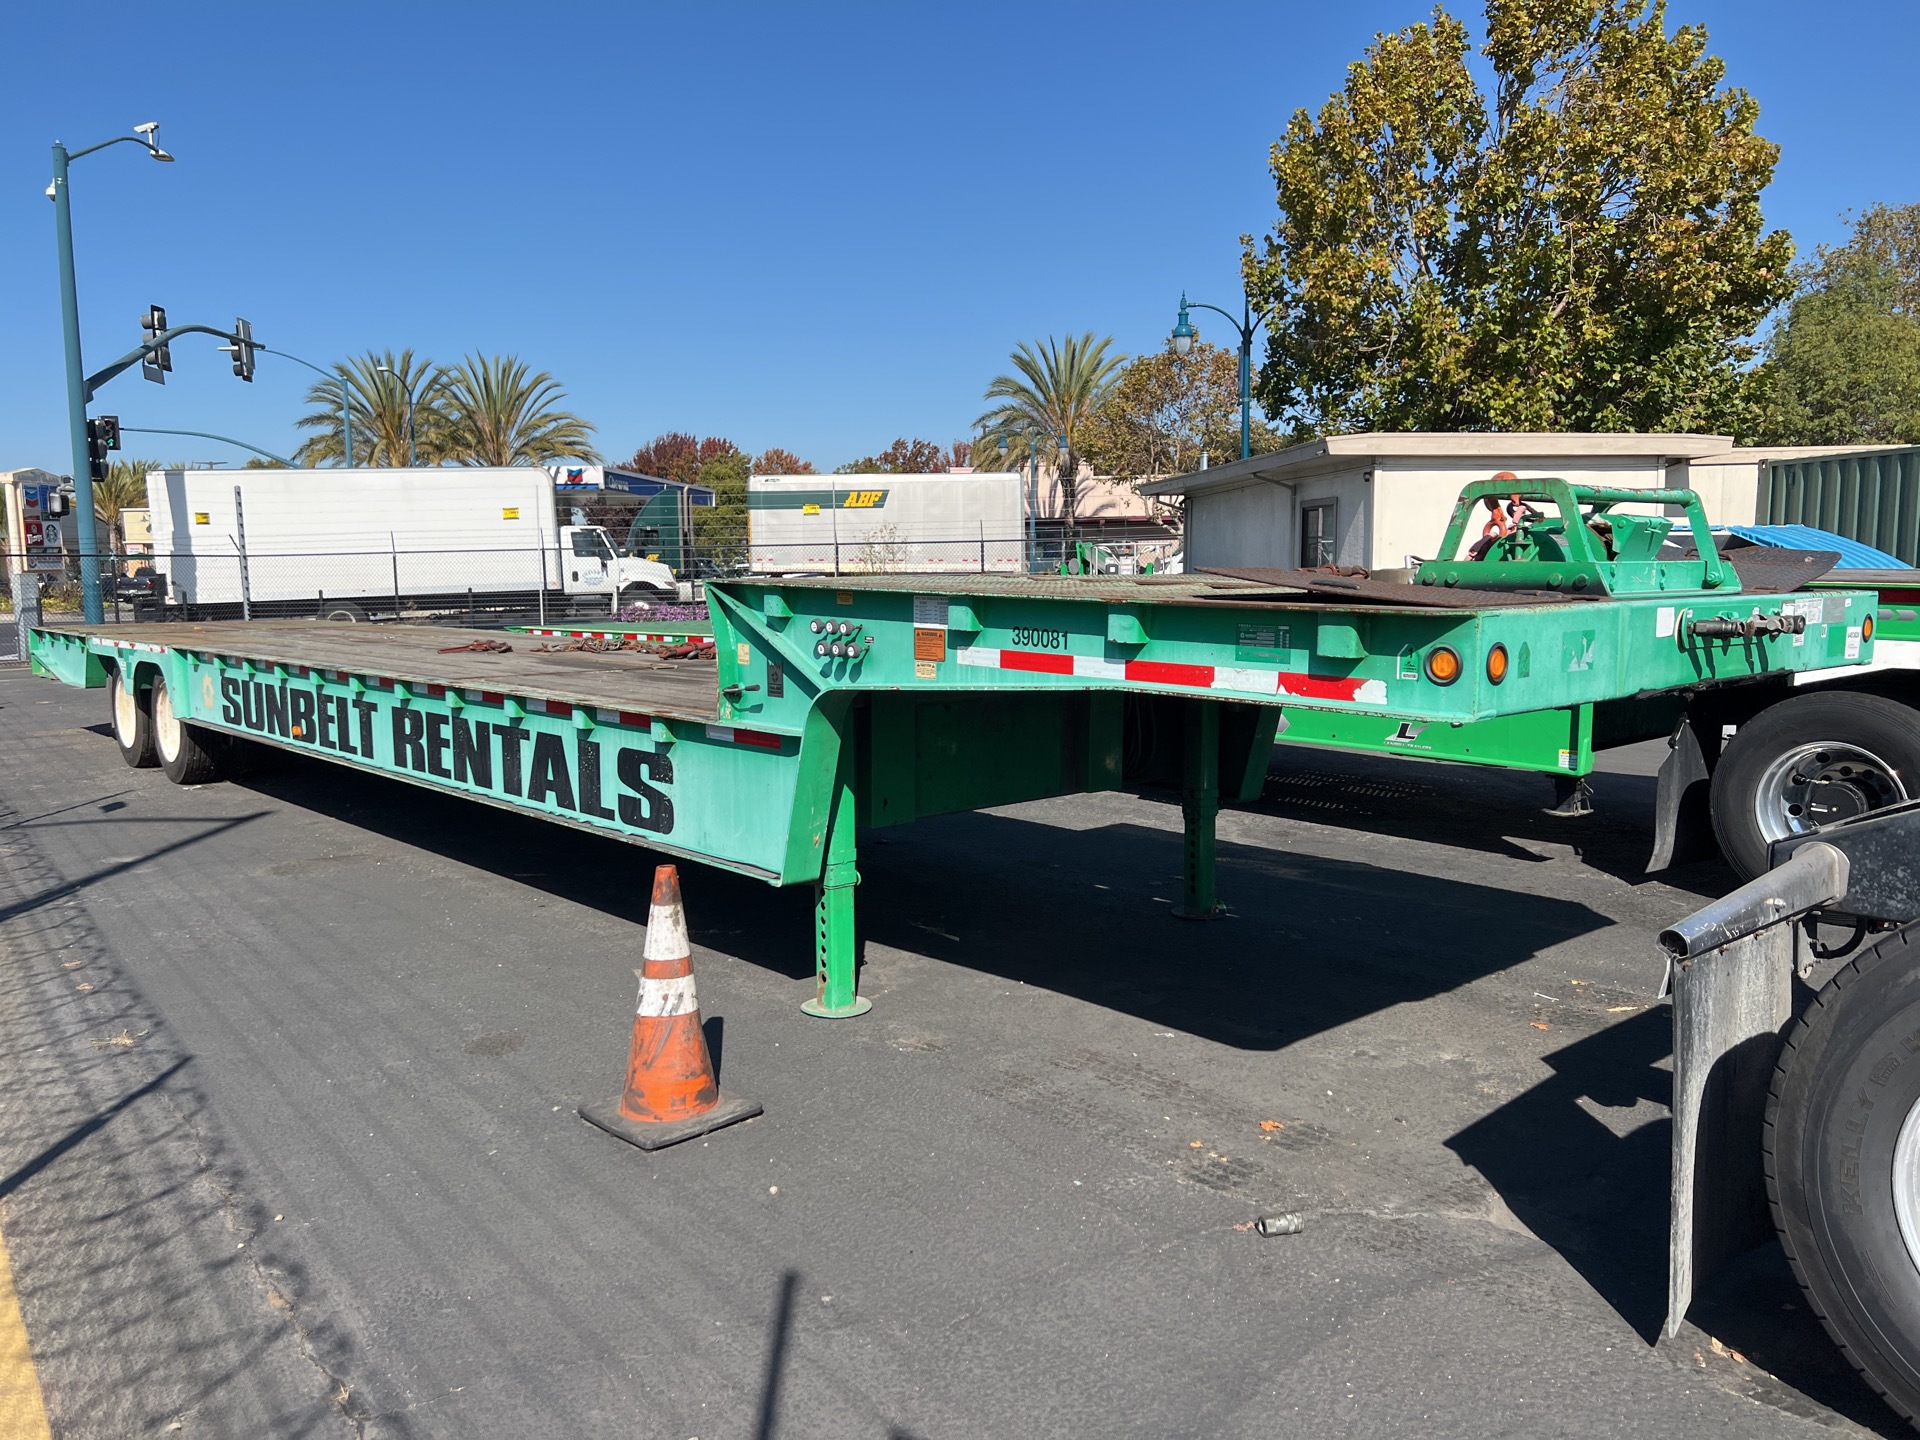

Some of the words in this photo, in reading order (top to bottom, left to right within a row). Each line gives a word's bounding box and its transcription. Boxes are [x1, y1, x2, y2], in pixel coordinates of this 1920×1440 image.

[843, 491, 883, 507] ABF
[1012, 626, 1068, 650] 390081
[222, 676, 378, 759] SUNBELT
[392, 706, 675, 835] RENTALS
[1840, 1086, 1875, 1216] KELLY
